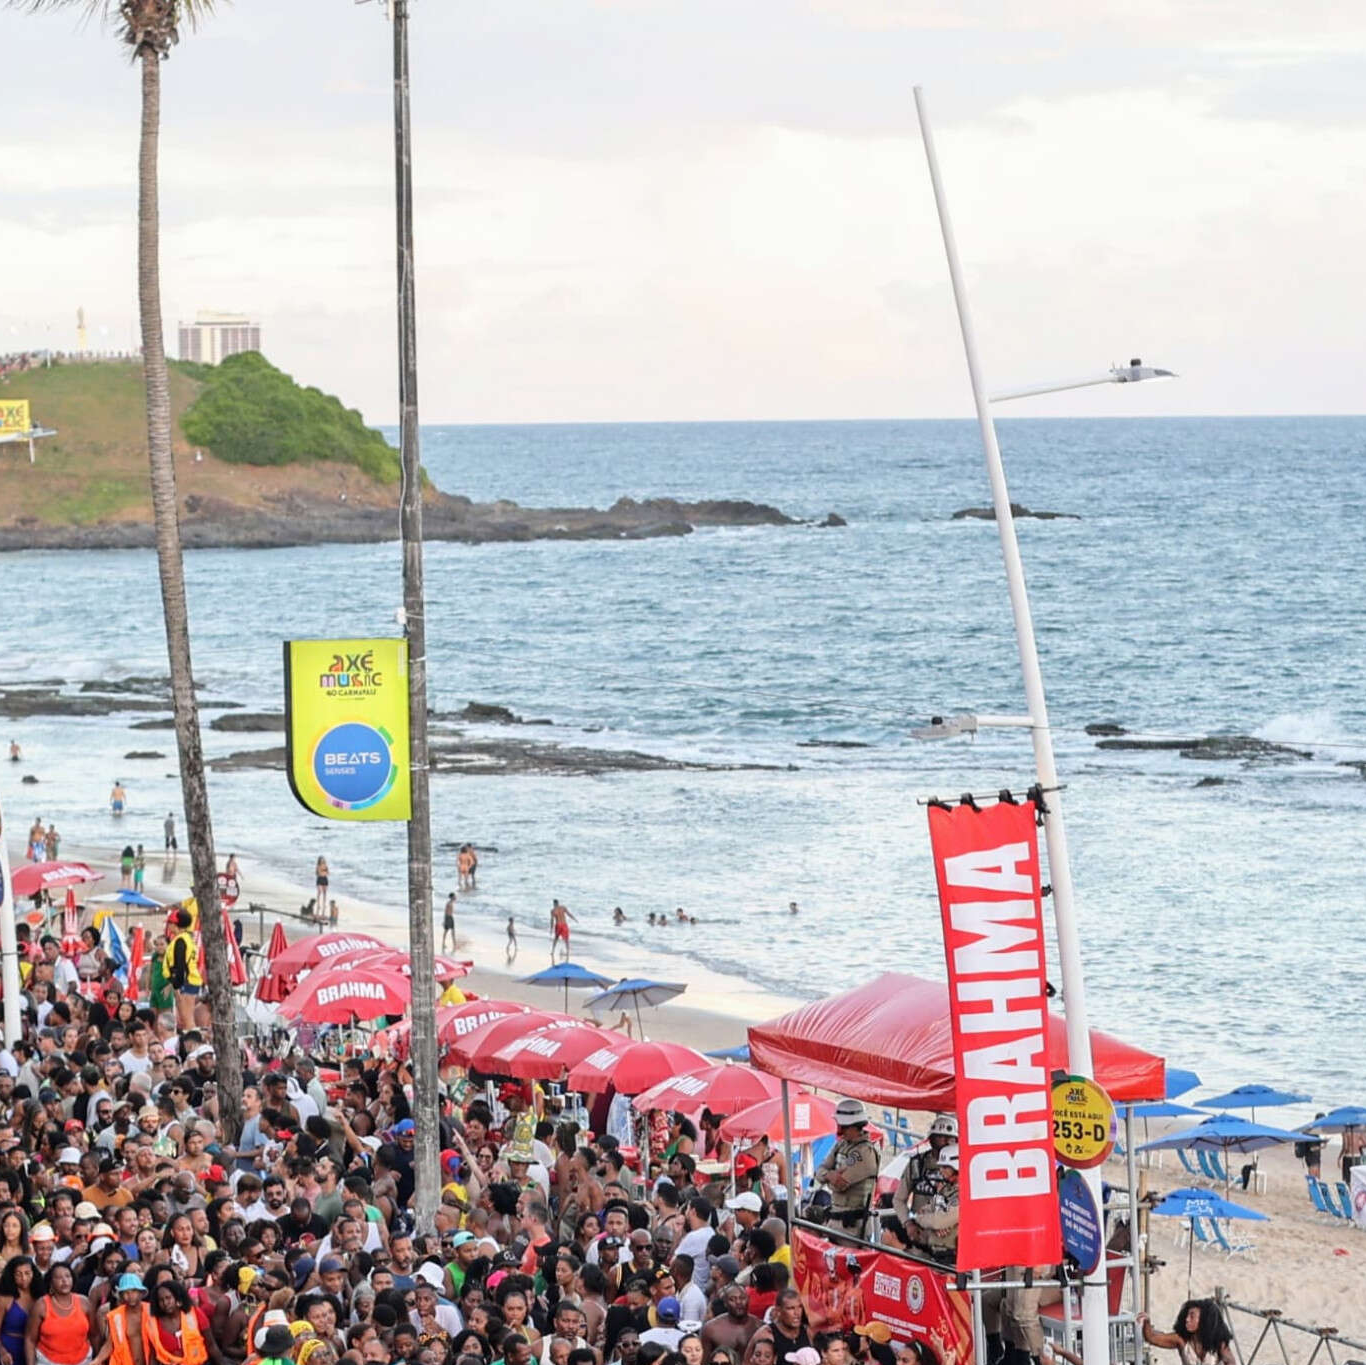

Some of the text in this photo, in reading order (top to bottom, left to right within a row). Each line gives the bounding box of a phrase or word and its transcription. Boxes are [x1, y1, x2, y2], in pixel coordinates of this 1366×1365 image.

[324, 751, 382, 765] BEATS
[317, 981, 387, 1005] BRAHMA
[943, 840, 1052, 1201] BRAHMA
[1053, 1120, 1105, 1143] 253-D
